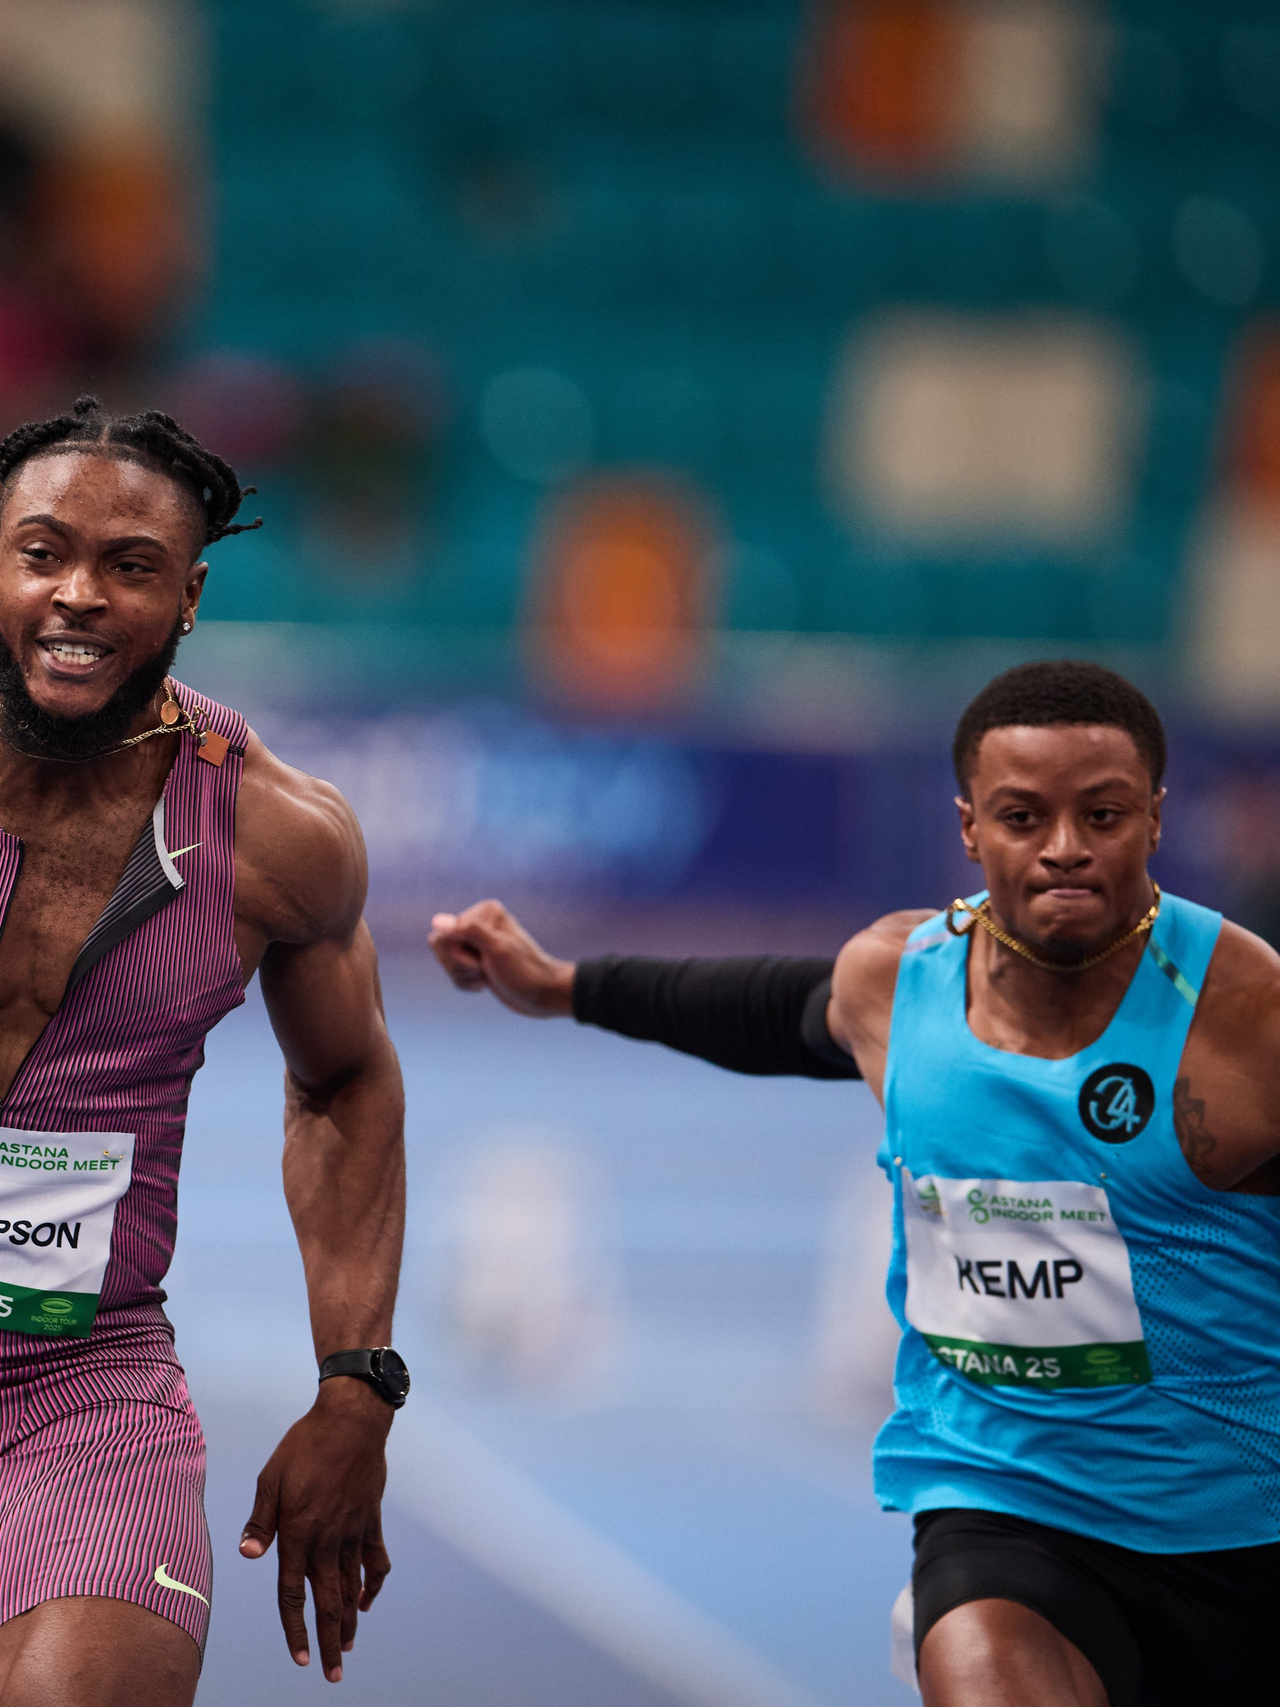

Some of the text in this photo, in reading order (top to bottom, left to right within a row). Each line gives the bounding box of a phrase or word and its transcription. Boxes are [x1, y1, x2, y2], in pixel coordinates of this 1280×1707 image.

[73, 1159, 120, 1171] MEET
[989, 1195, 1053, 1209] ASTANA
[991, 1208, 1107, 1222] INDOOR MEET
[954, 1255, 1083, 1299] KEMP
[928, 1346, 1019, 1378] STANA
[1025, 1356, 1061, 1378] 25
